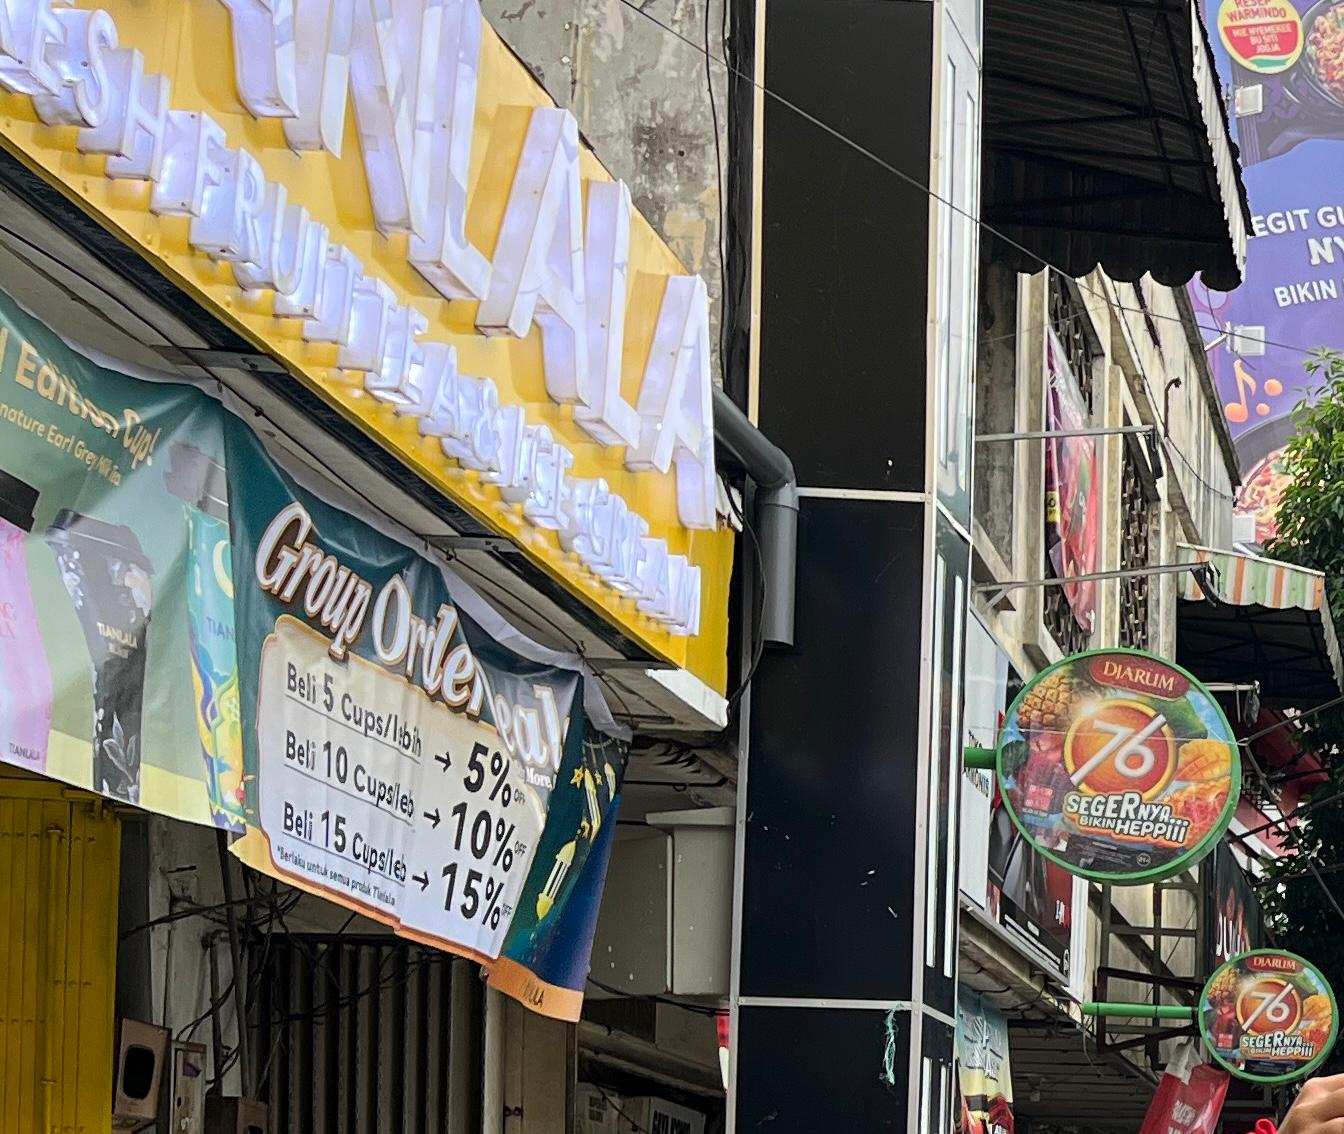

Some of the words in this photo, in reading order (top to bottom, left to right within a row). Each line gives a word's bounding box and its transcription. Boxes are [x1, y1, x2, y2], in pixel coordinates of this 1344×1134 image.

[1226, 7, 1287, 22] WARMINDO
[1274, 279, 1339, 308] BIKIN
[47, 426, 75, 457] Earl
[74, 441, 98, 472] Grey
[255, 501, 373, 661] Group
[1103, 660, 1176, 692] DJARUM
[287, 661, 317, 704] Beli
[323, 672, 335, 712] 5
[463, 741, 512, 808] 5%
[1070, 712, 1168, 787] 76
[286, 729, 316, 771] Beli
[322, 740, 349, 784] 10
[451, 801, 516, 873] 10%
[1080, 816, 1117, 830] BIKIN
[283, 800, 314, 842] Beli
[321, 809, 347, 854] 15
[442, 861, 505, 931] 15%
[1253, 955, 1297, 970] DJARUM
[1242, 982, 1294, 1032] 76
